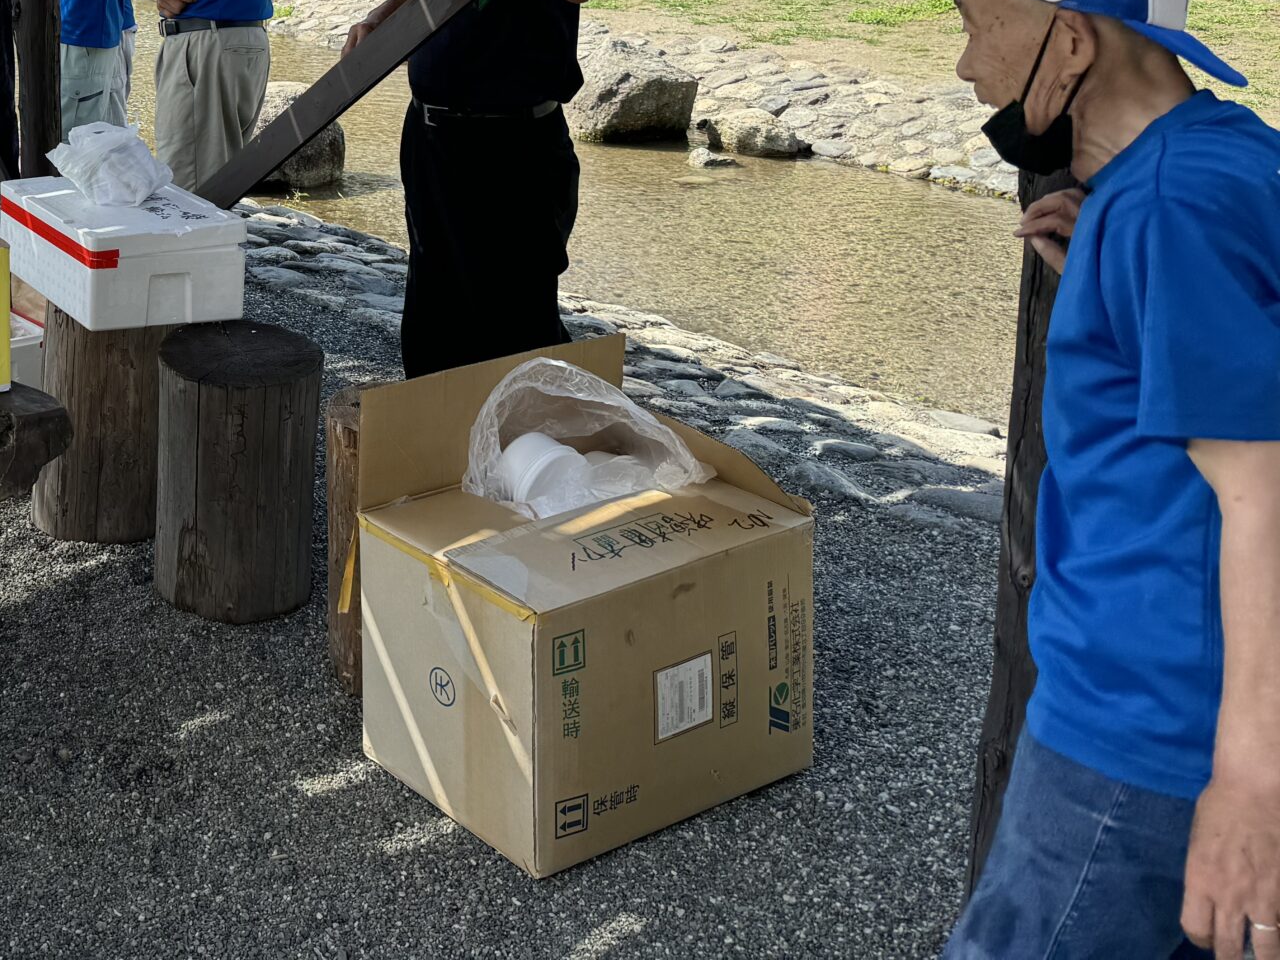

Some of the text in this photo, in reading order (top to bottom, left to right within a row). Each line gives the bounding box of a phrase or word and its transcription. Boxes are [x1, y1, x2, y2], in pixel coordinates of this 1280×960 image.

[720, 640, 736, 721] 縦保管
[790, 601, 802, 732] 東名化学工業株式会社
[560, 678, 582, 740] 輸送時
[593, 784, 640, 816] 保管時
